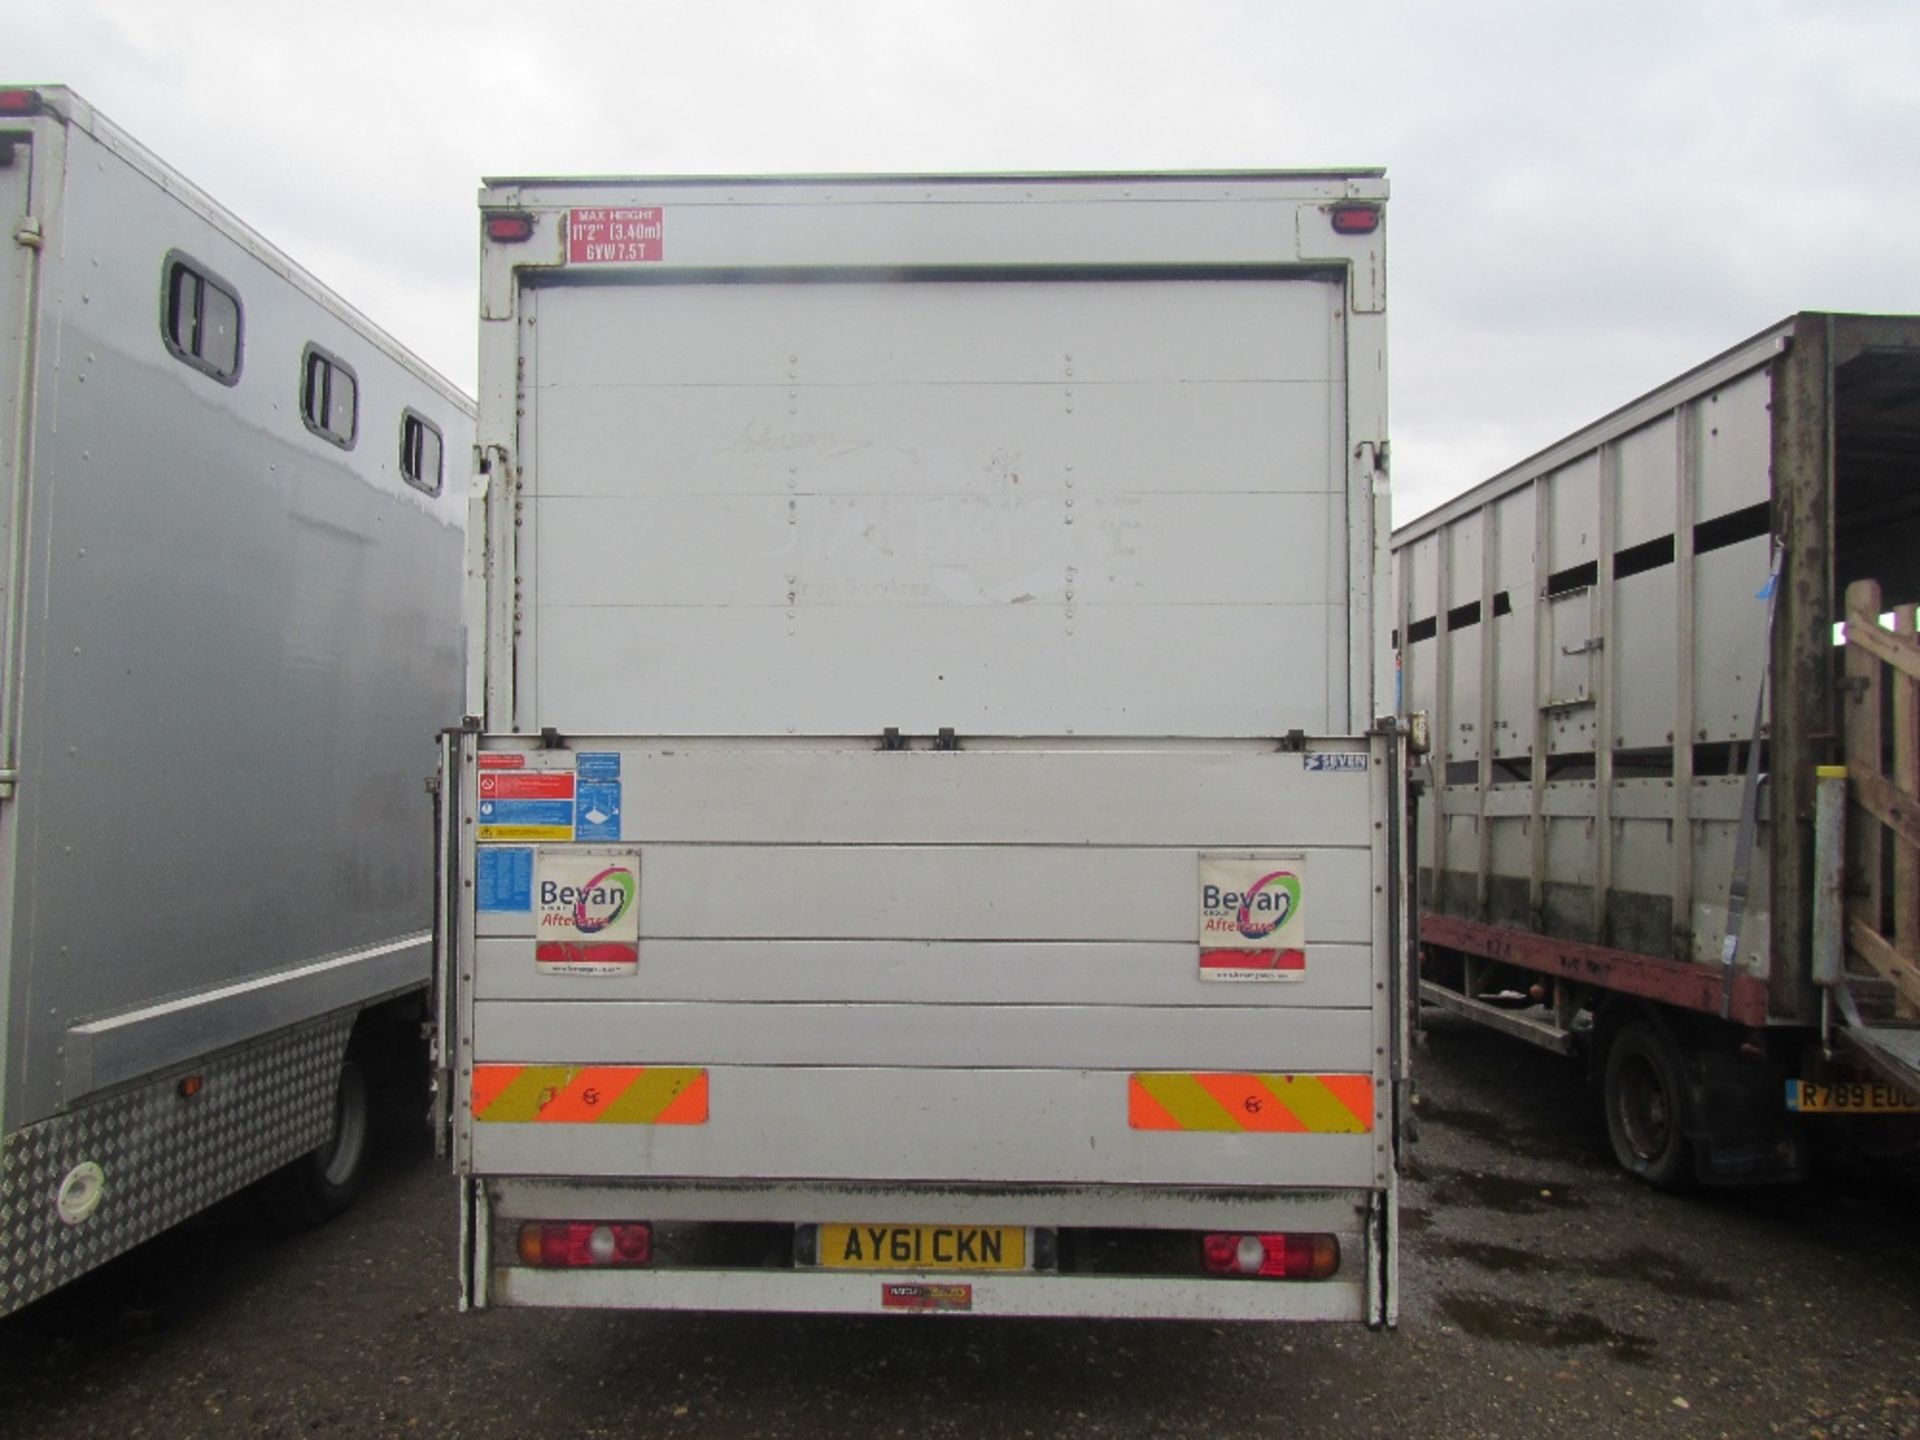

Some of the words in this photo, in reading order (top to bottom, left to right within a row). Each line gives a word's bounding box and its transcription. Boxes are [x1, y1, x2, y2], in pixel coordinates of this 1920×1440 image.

[579, 210, 606, 221] MAX
[586, 243, 616, 261] GVW
[541, 880, 626, 905] Bevan
[1203, 884, 1291, 911] Bevan
[1802, 1083, 1866, 1107] R789
[843, 1228, 922, 1261] AY61
[932, 1229, 1003, 1263] CKN
